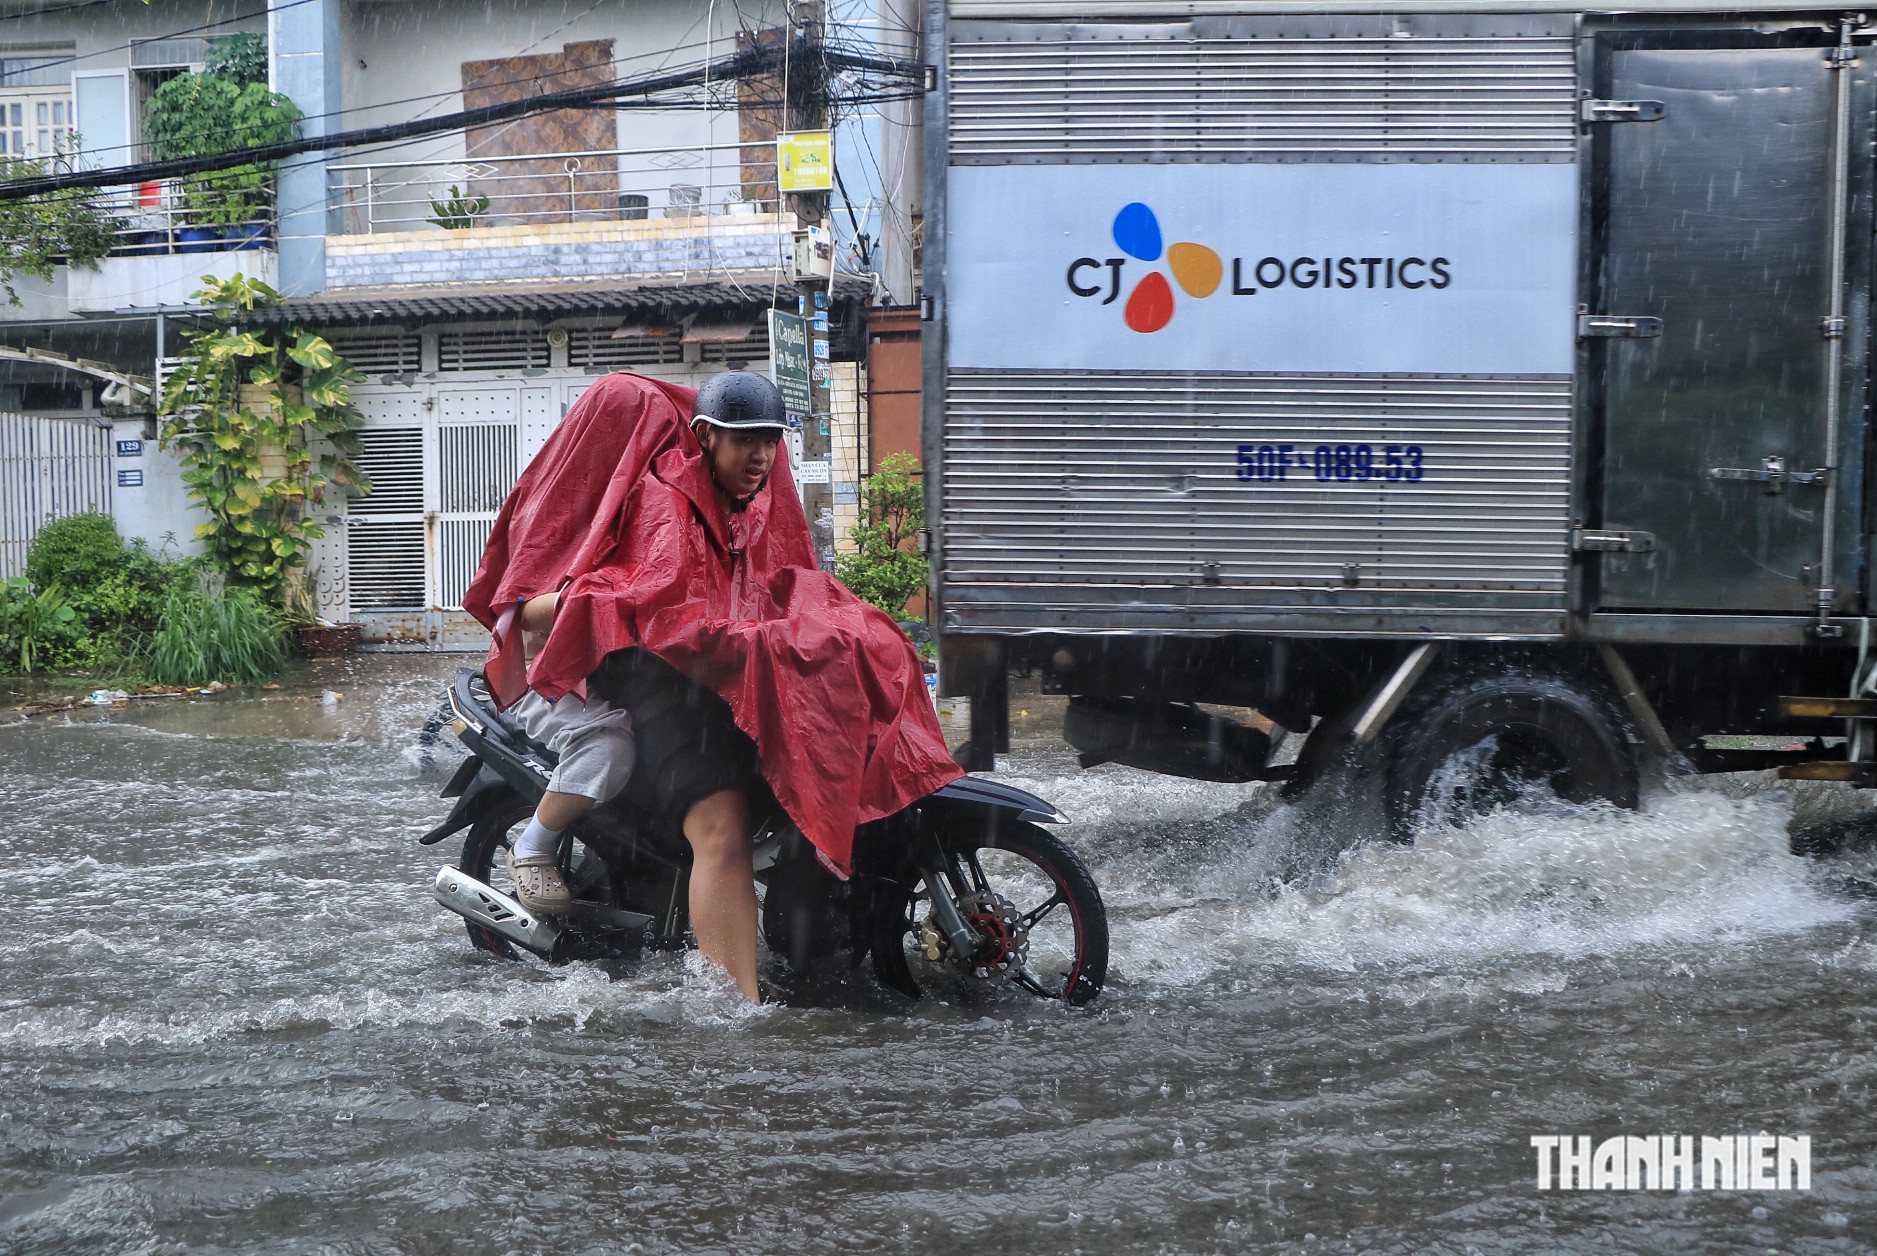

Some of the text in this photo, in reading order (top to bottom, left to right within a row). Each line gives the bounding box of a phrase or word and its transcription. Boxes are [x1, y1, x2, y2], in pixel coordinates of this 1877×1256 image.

[1066, 257, 1452, 306] CJ LOGISTICS
[778, 319, 805, 348] Capella
[120, 441, 139, 451] 129
